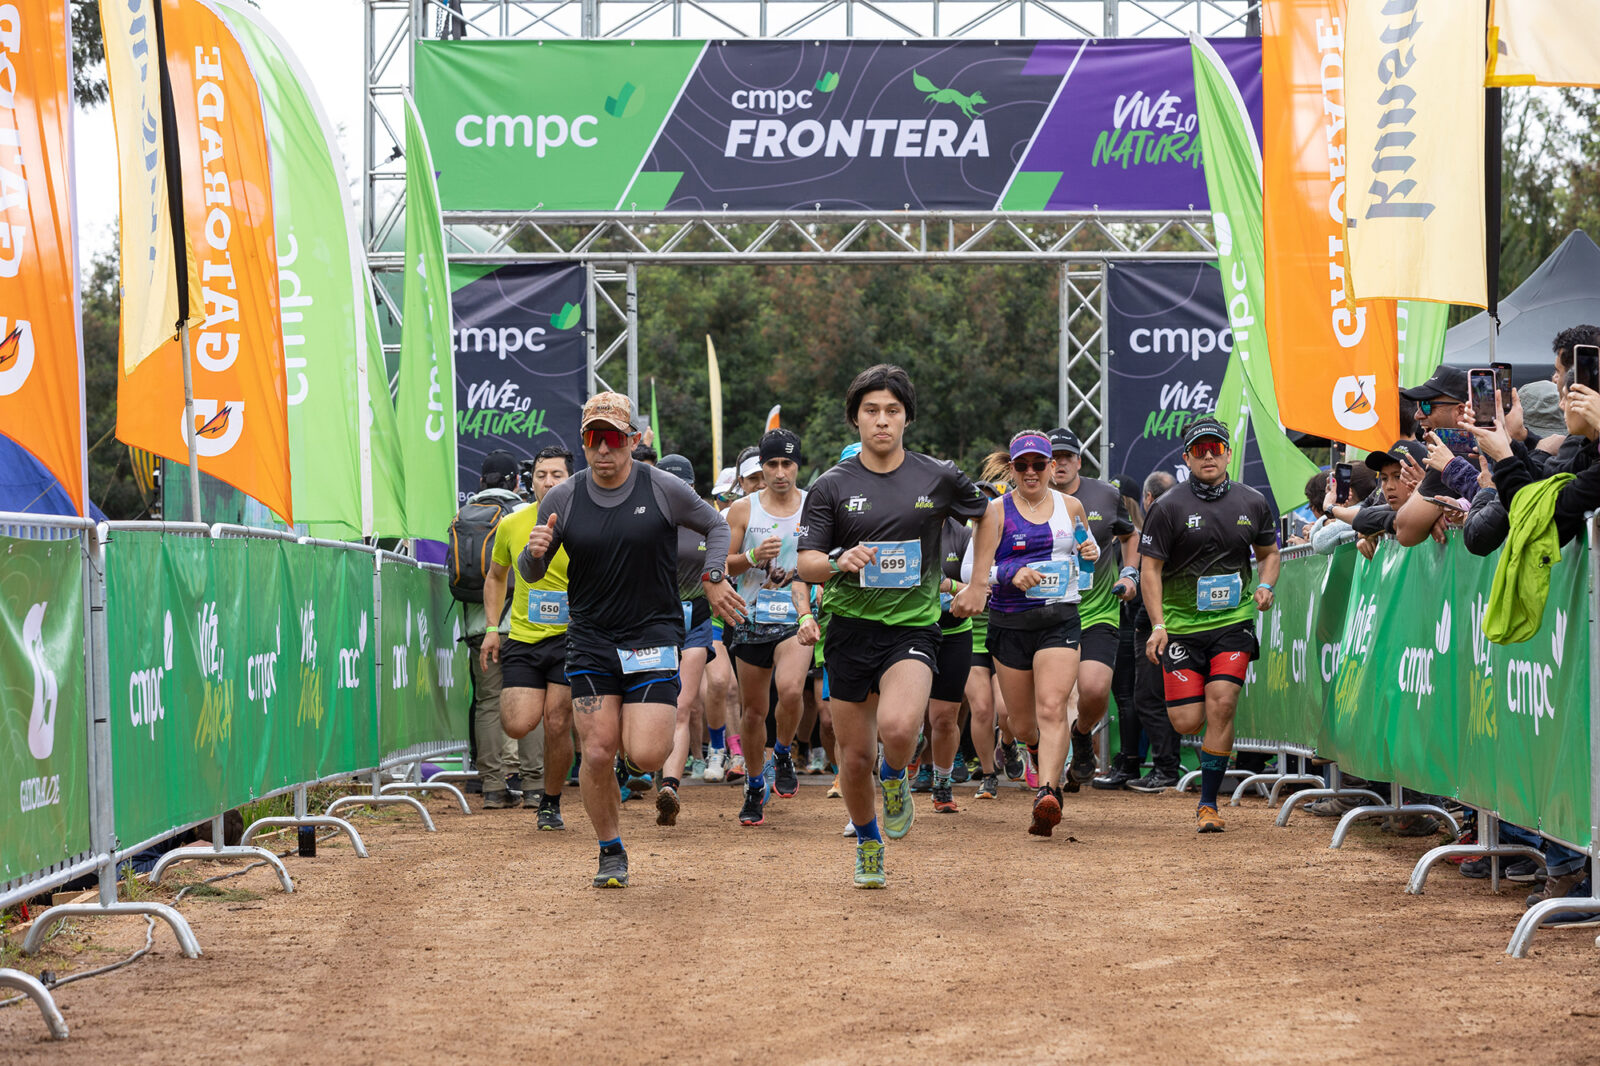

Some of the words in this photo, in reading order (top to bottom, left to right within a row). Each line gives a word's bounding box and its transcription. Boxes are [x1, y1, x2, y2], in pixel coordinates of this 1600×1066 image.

[731, 88, 814, 115] cmpc
[1113, 90, 1182, 129] VIVE
[1173, 113, 1198, 134] LO
[455, 114, 599, 158] cmpc
[724, 119, 990, 158] FRONTERA
[1091, 128, 1205, 169] NATURA
[451, 326, 546, 360] mpc
[467, 379, 520, 410] VIVE
[513, 396, 532, 412] LO
[1160, 380, 1212, 411] VIVE
[456, 408, 550, 439] NATURAL
[1193, 427, 1218, 435] GARMIN
[749, 526, 771, 535] cmpc
[540, 604, 559, 613] 650
[769, 603, 788, 613] 664
[1211, 590, 1230, 599] 637
[1398, 646, 1433, 710] cmpc
[129, 666, 165, 740] cmpc
[1507, 658, 1555, 736] cmpc
